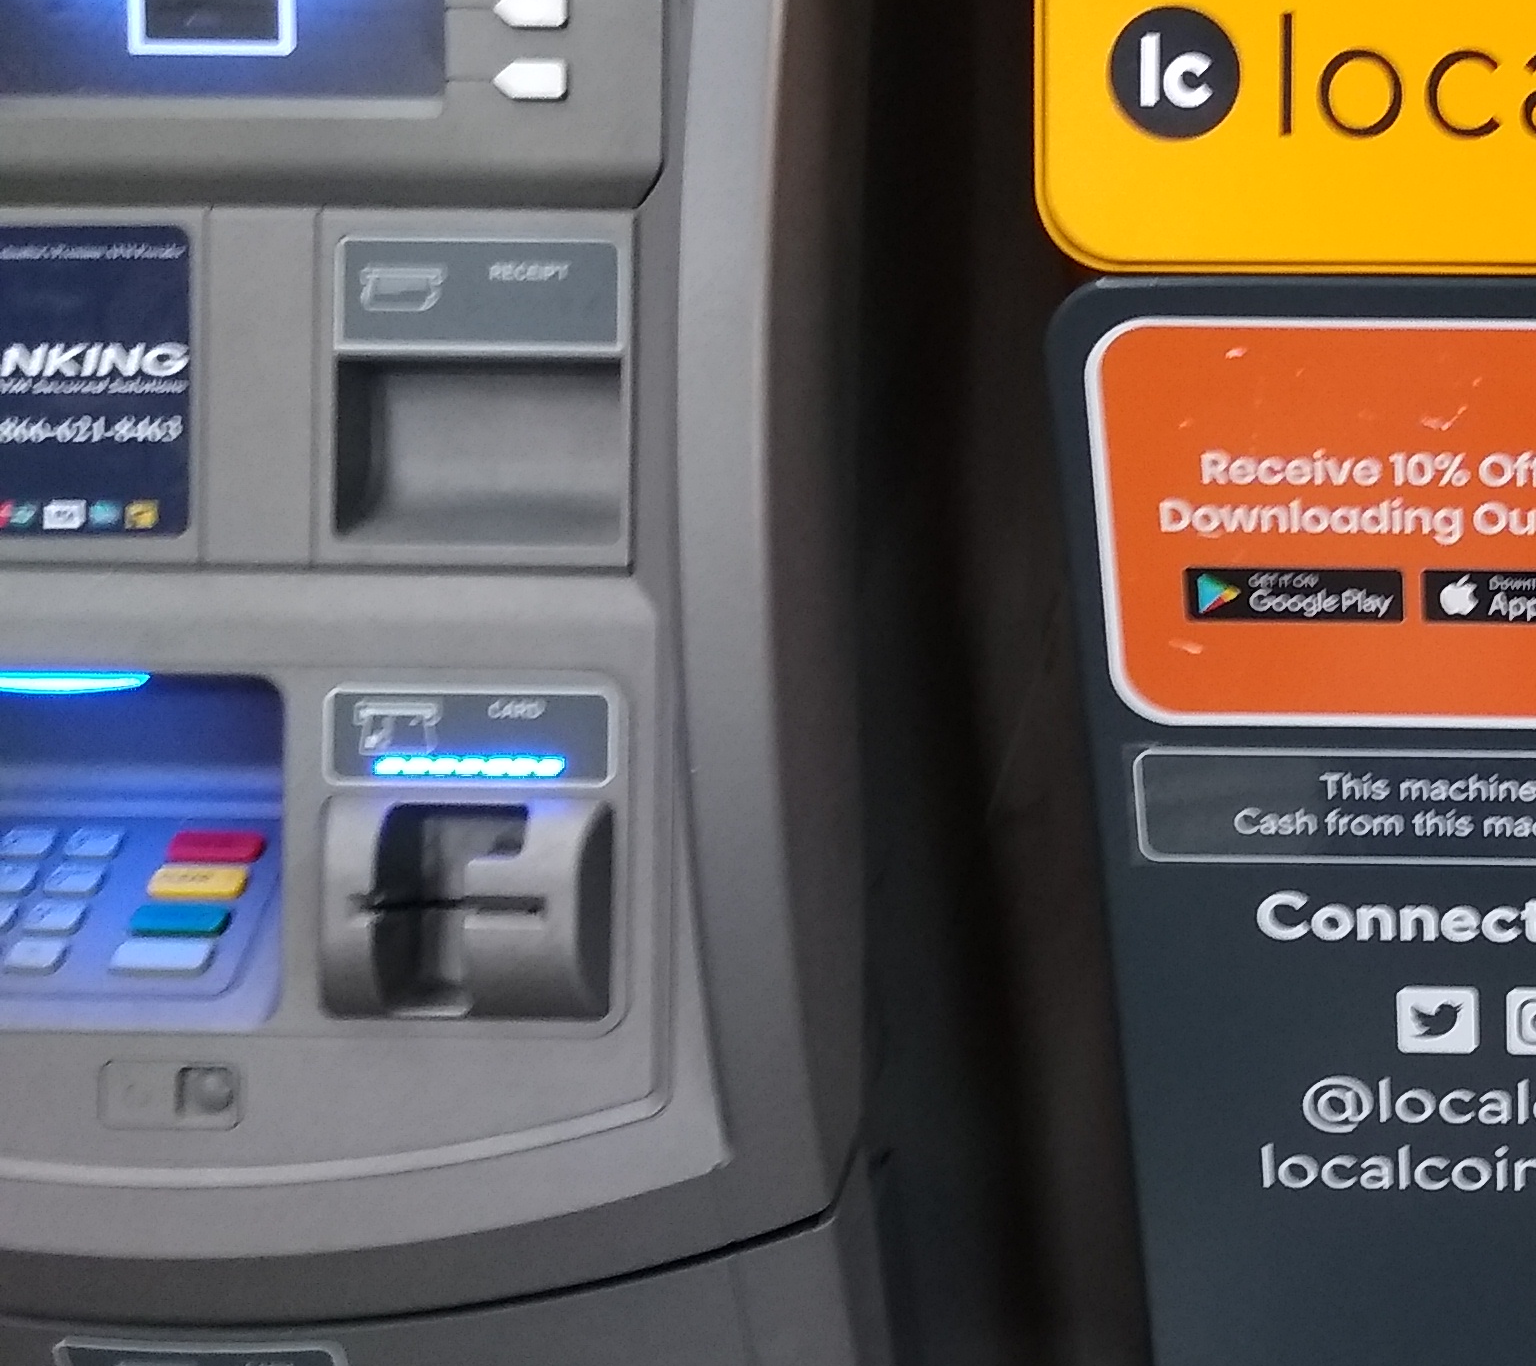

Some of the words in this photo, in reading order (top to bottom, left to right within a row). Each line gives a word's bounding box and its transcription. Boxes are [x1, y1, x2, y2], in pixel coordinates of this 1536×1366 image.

[1139, 30, 1213, 110] lc
[1199, 448, 1383, 487] Receive
[1388, 451, 1472, 488] 10%
[1158, 496, 1464, 546] Downloading
[1248, 588, 1340, 618] Google
[1341, 589, 1396, 619] Play
[1319, 770, 1391, 803] This
[1232, 805, 1319, 837] Cash
[1325, 807, 1405, 837] from
[1411, 808, 1476, 838] this
